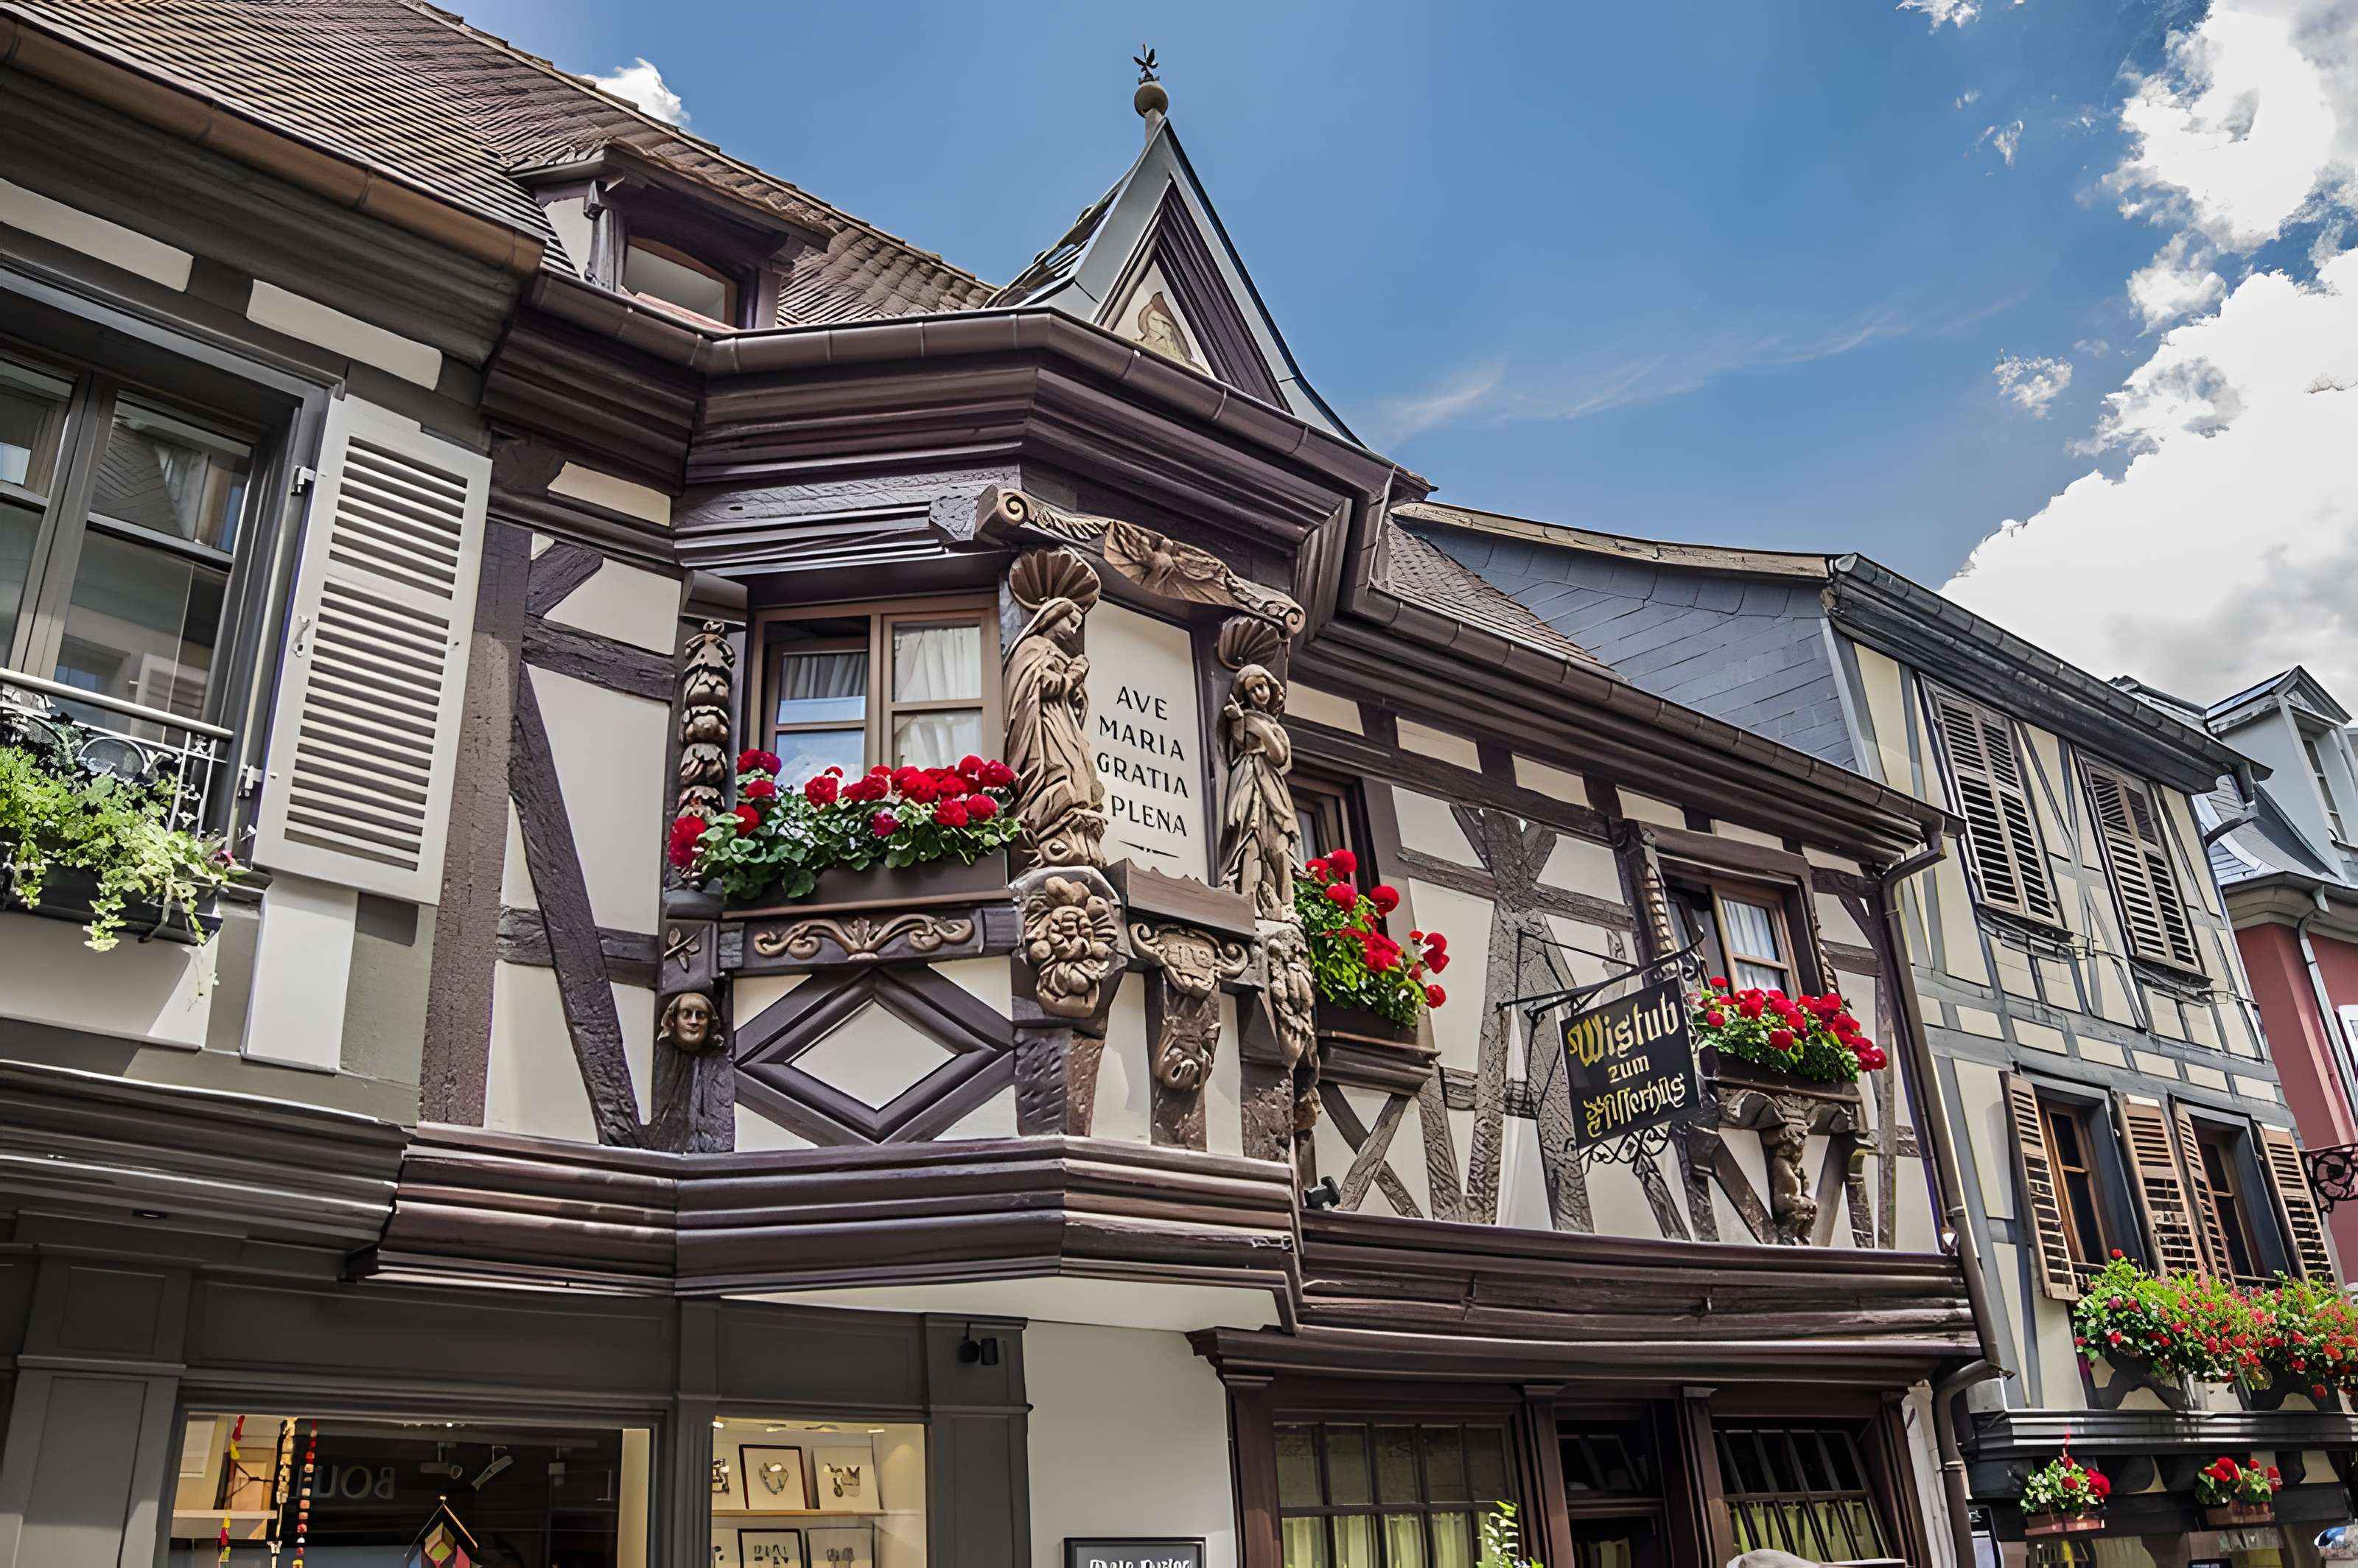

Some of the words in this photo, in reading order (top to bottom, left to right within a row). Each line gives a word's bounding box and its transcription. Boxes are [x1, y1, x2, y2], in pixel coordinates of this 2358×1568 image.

[1116, 685, 1168, 721] AVE
[1099, 715, 1185, 762] MARIA
[1096, 752, 1189, 799] GRATIA
[1111, 794, 1187, 837] PLENA
[1567, 992, 1679, 1068] Wistub
[1608, 1055, 1650, 1084] zum
